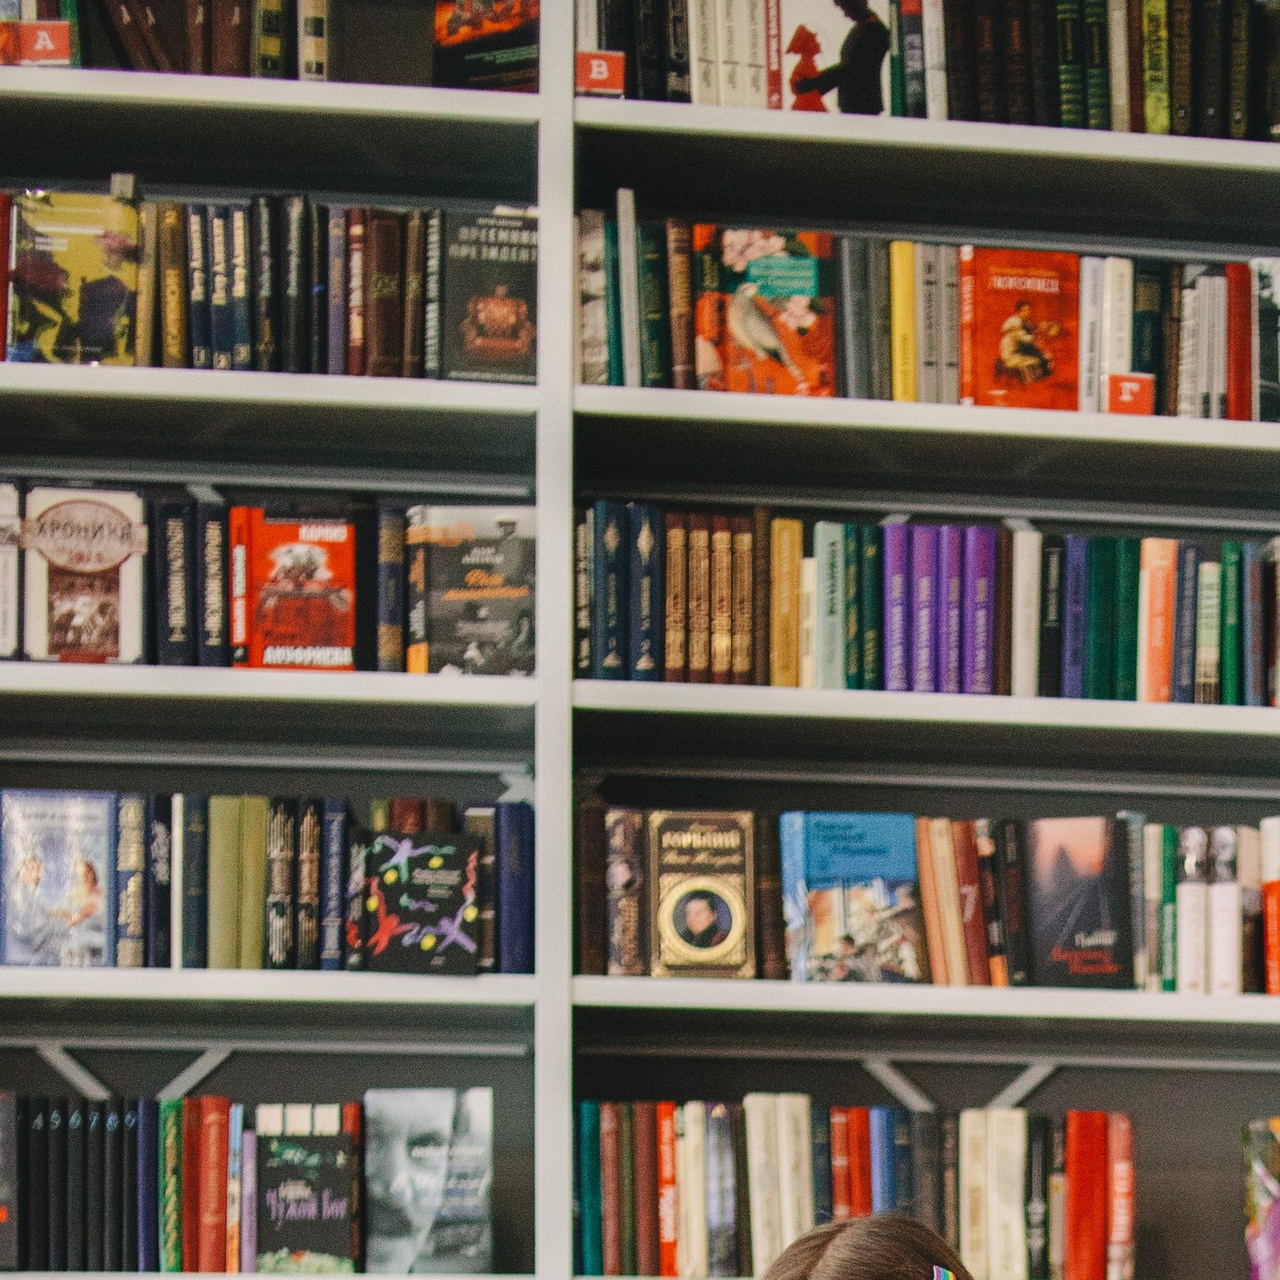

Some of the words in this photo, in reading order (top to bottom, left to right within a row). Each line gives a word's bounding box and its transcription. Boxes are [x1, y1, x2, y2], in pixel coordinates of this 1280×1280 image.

[34, 30, 54, 51] А
[589, 58, 609, 80] В
[1118, 381, 1141, 402] Г
[36, 519, 132, 541] ХРОНИКА
